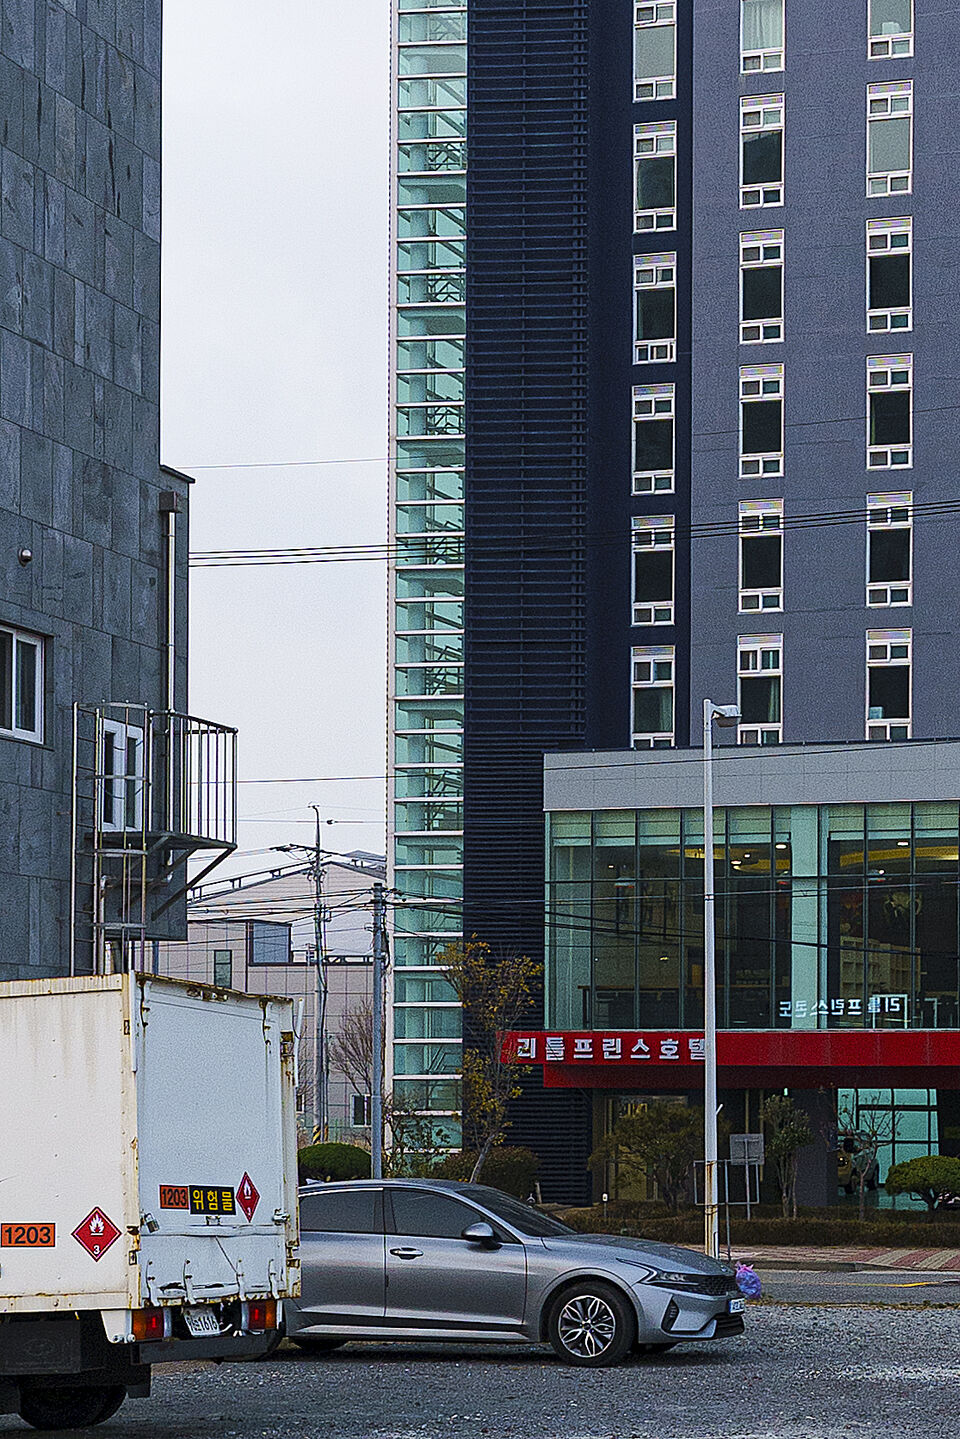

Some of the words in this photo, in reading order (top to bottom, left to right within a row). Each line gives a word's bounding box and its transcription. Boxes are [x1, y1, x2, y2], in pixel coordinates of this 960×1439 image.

[162, 1188, 187, 1207] 1203
[193, 1189, 233, 1211] 위험물
[4, 1226, 51, 1244] 1203
[93, 1245, 100, 1255] 3
